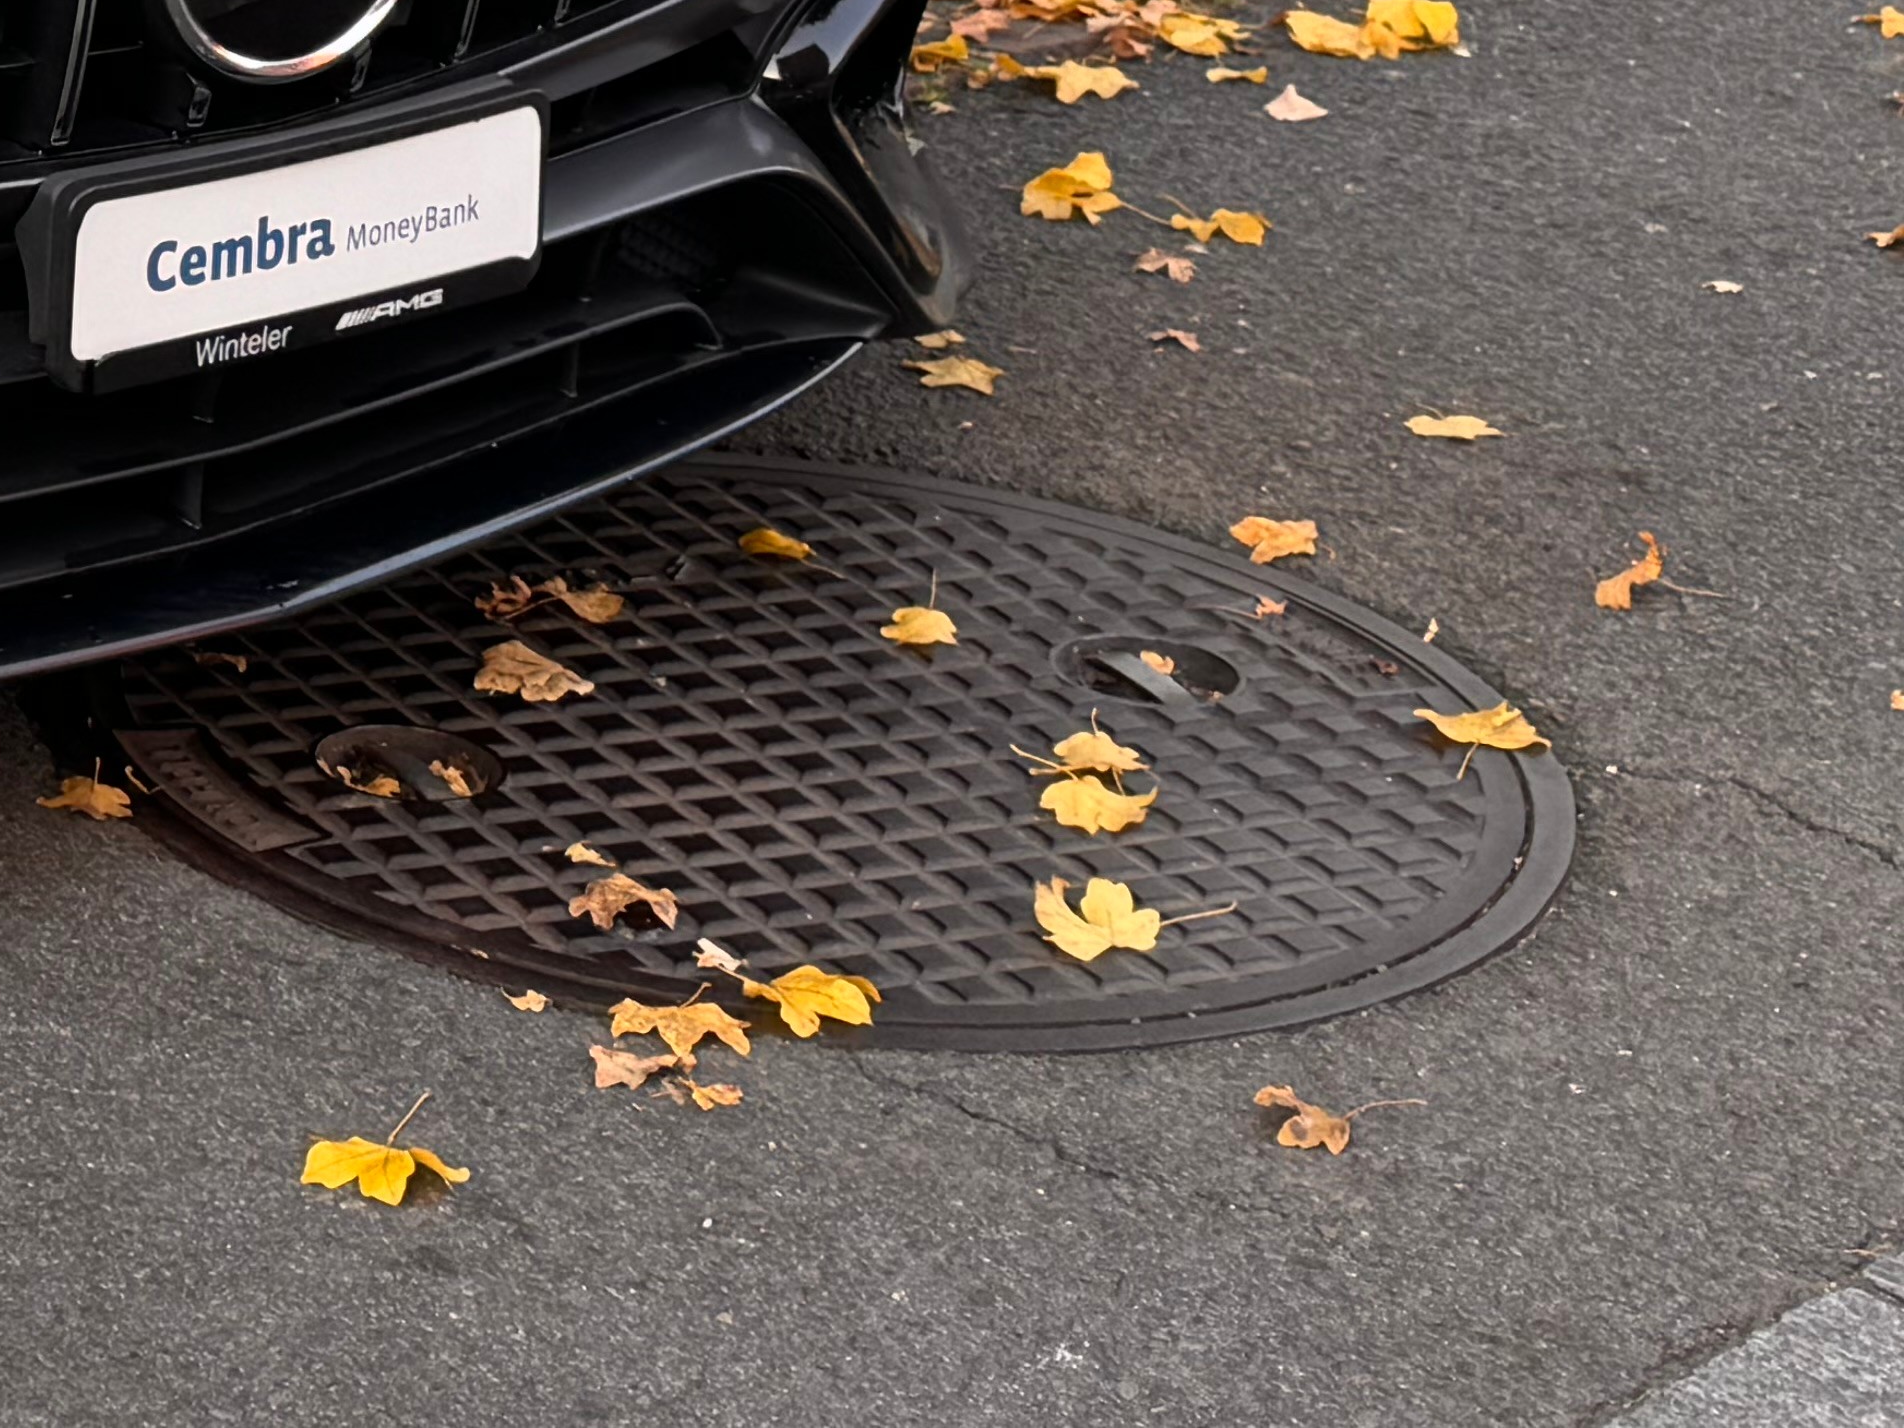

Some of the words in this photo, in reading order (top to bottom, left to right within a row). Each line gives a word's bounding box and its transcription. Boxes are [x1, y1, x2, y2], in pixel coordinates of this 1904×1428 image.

[146, 213, 335, 293] Cembra
[346, 194, 480, 253] MoneyBank
[372, 288, 444, 320] AMG
[194, 323, 293, 368] Winteler
